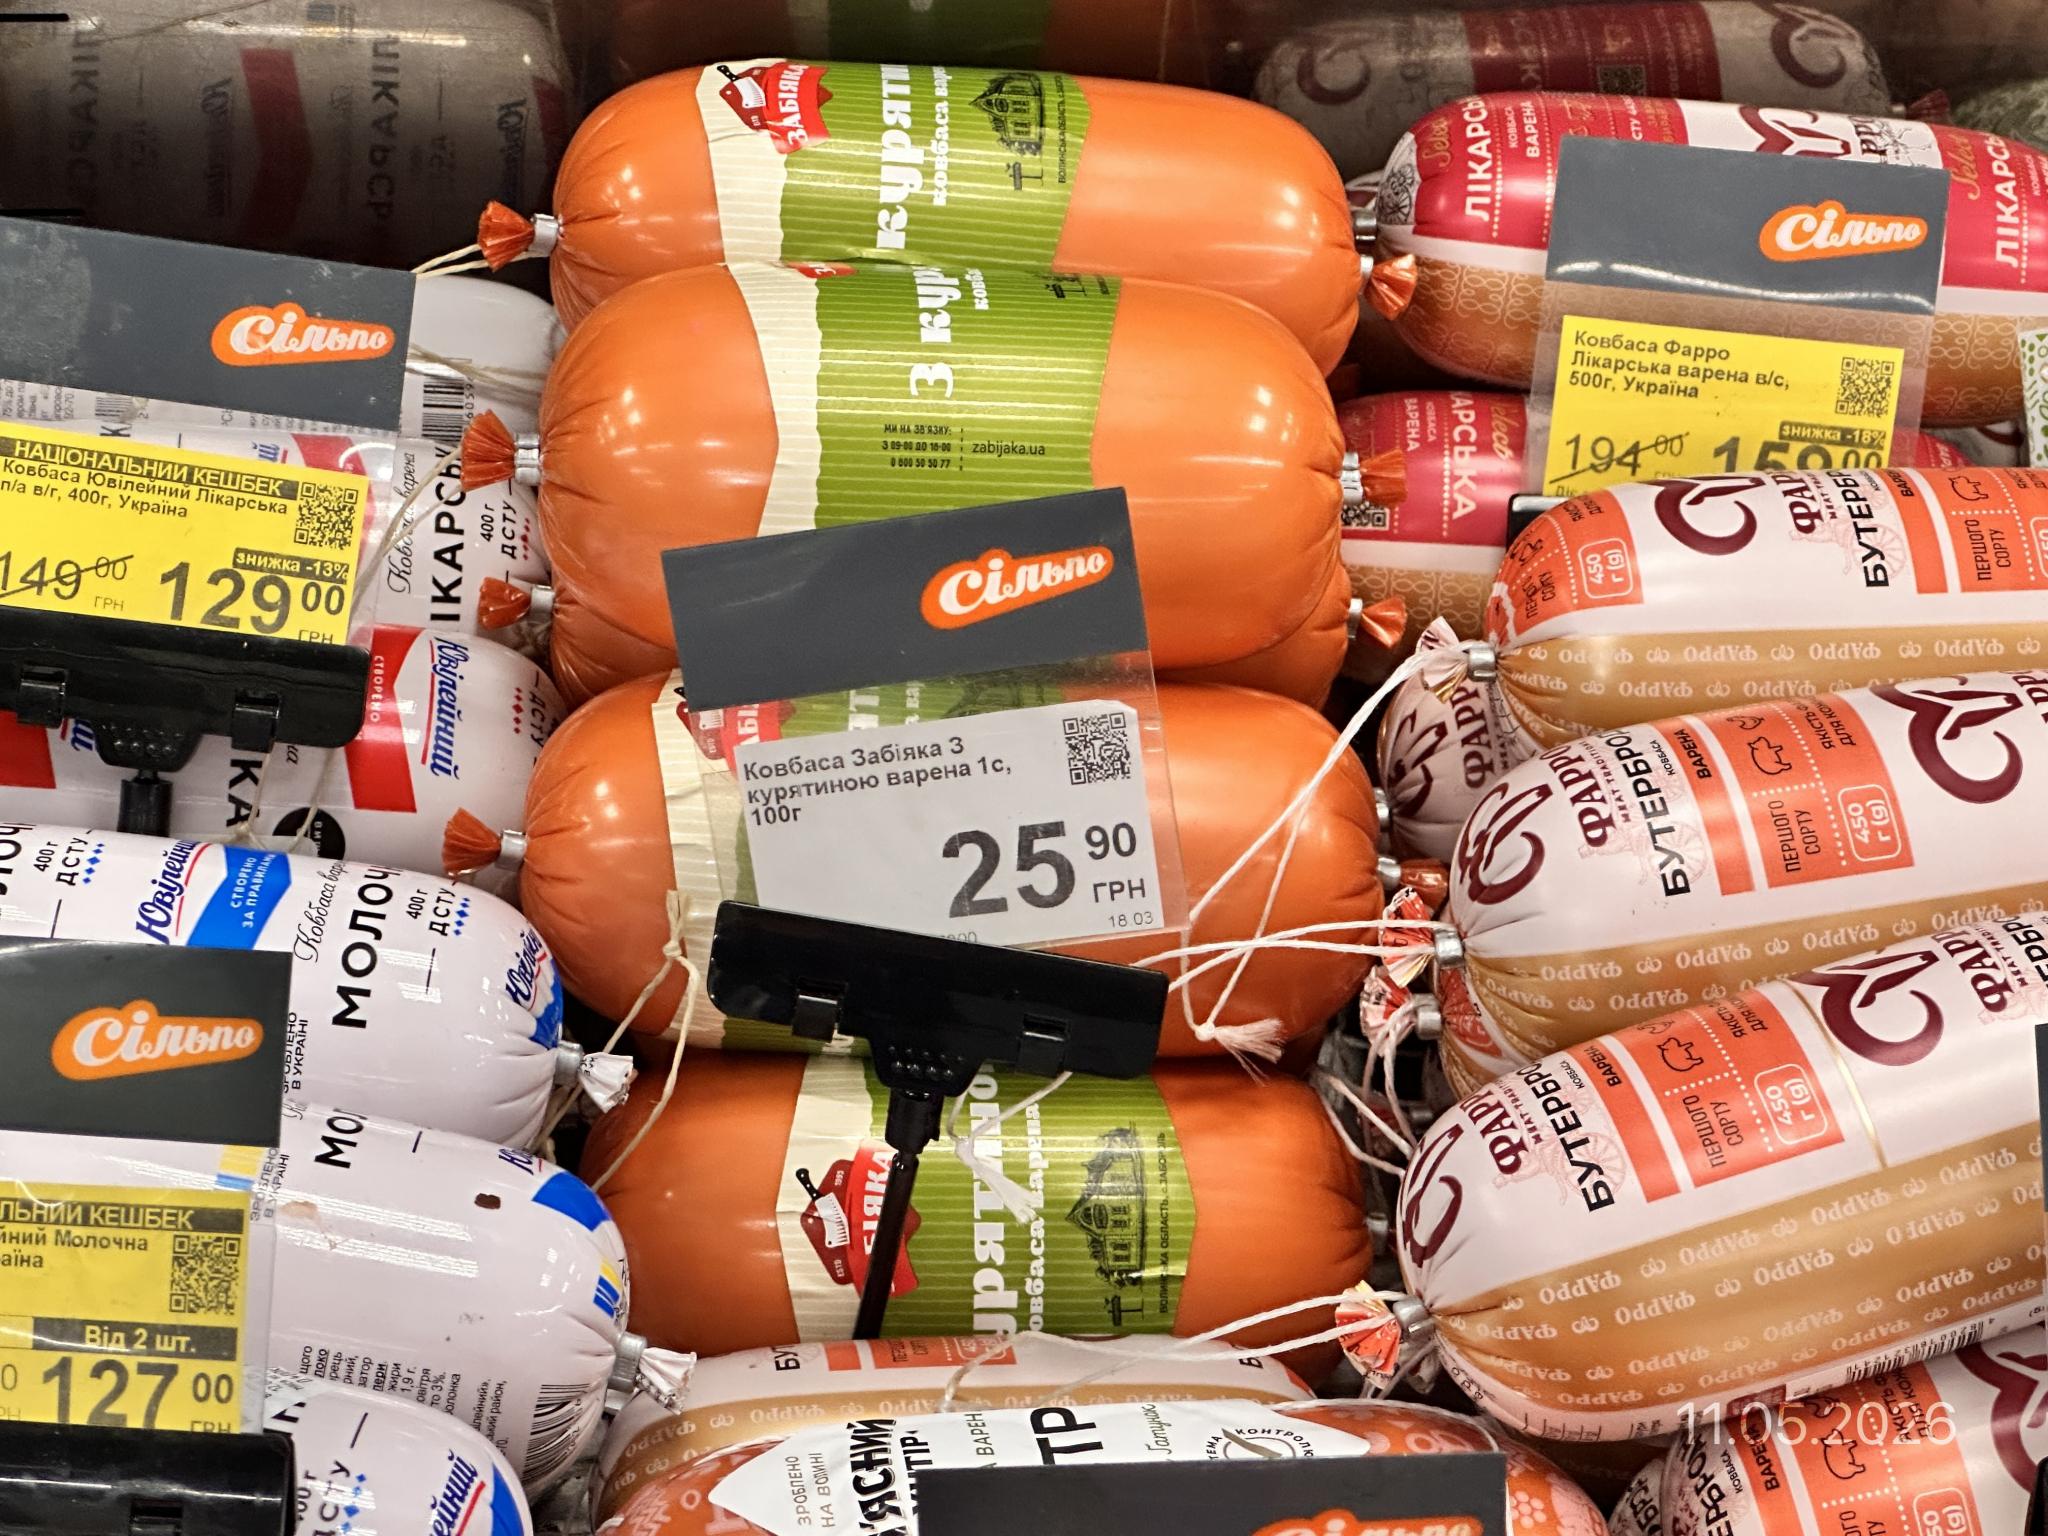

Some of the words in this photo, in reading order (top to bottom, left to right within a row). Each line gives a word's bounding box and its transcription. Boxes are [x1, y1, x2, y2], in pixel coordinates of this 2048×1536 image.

[1526, 100, 1541, 158] ВАРЕНА
[1775, 207, 1922, 252] Сільпо
[229, 311, 388, 355] Сільпо
[1574, 331, 1658, 354] Ковбаса
[1663, 341, 1731, 362] Фарро
[1569, 371, 1616, 393] 500г,
[1622, 376, 1700, 399] Україна
[1570, 351, 1672, 376] Лікарська
[1677, 364, 1749, 387] варена
[1754, 372, 1791, 391] в/с,
[972, 440, 1046, 458] zabijaka.ua
[1565, 434, 1641, 477] 194
[1781, 425, 1841, 442] знижка
[1846, 430, 1886, 447] -18%
[3, 461, 81, 484] Ковбаса
[86, 471, 191, 501] Ювілейний
[195, 487, 289, 516] Лікарська
[15, 440, 190, 484] НАЦІОНАЛЬНИЙ
[193, 467, 283, 497] КЕШБЕК
[68, 488, 112, 509] 400г,
[118, 494, 189, 519] Україна
[480, 513, 495, 542] 400
[502, 500, 517, 560] ДСТУ
[1989, 528, 2012, 568] СОРТУ
[234, 550, 301, 573] знижка
[304, 560, 349, 580] -13%
[1586, 553, 1605, 585] 450
[1965, 518, 1992, 582] ПЕРШОГО
[94, 596, 125, 612] ГРН
[160, 560, 291, 635] 129
[299, 580, 347, 617] 00
[939, 551, 1107, 616] Сільпо
[369, 655, 385, 723] СТВОРЕНО
[743, 747, 846, 782] Ковбаса
[850, 736, 943, 769] Забіяка
[1648, 739, 1676, 776] КОВБАСА
[1672, 728, 1713, 780] ВАРЕНА
[746, 773, 881, 807] курятиною
[886, 761, 972, 787] варена
[976, 754, 1012, 778] 1с,
[750, 805, 803, 828] 100г
[1793, 808, 1821, 855] СОРТУ
[1847, 802, 1870, 844] 450
[1865, 798, 1891, 826] (g)
[1767, 799, 1802, 873] ПЕРШОГО
[33, 849, 55, 873] 400
[56, 837, 90, 887] ДСТУ
[229, 856, 258, 909] СТВОРЕНО
[941, 820, 1077, 920] 25
[1084, 821, 1138, 860] 90
[405, 896, 427, 920] 400
[429, 887, 457, 937] ДСТУ
[1091, 877, 1147, 904] ГРН
[242, 910, 257, 929] ЗА
[293, 881, 338, 963] Ковбаса
[73, 1009, 256, 1067] Сільпо
[293, 1019, 309, 1077] УКРАЇНІ
[1559, 1060, 1586, 1090] КОВБАСА
[1583, 1044, 1623, 1088] ВАРЕНА
[1764, 1085, 1794, 1126] 450
[1783, 1077, 1812, 1106] (g)
[1681, 1093, 1728, 1168] ПЕРШОГО
[1709, 1100, 1744, 1147] СОРТУ
[53, 1229, 149, 1251] Молочна
[88, 1206, 195, 1231] КЕШБЕК
[84, 1324, 126, 1350] Від
[133, 1328, 149, 1350] 2
[154, 1331, 196, 1354] шт.
[42, 1356, 179, 1430] 127
[192, 1372, 234, 1404] 00
[785, 1455, 812, 1526] ЗРОБЛЕНО
[808, 1452, 832, 1497] ВОЛИНІ
[821, 1503, 836, 1528] НА
